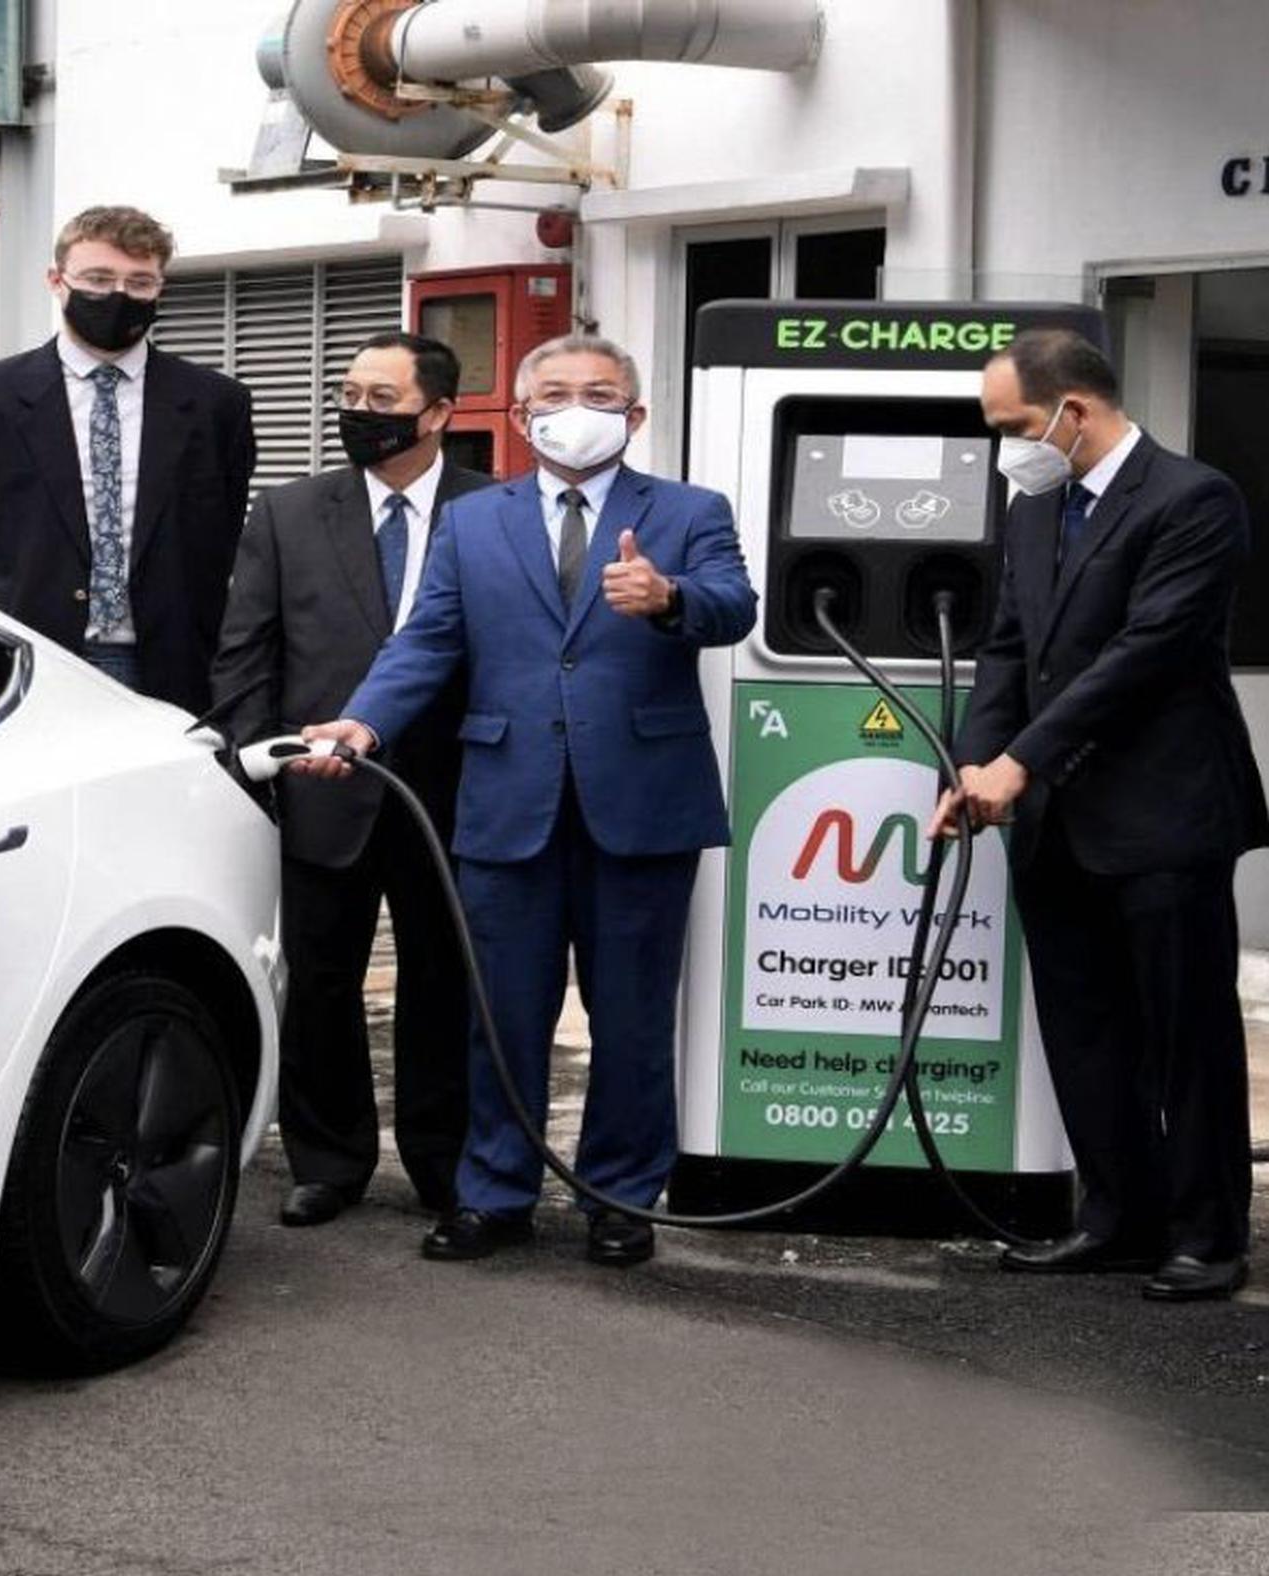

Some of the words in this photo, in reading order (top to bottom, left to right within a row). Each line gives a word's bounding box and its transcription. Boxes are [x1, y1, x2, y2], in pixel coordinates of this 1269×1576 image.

[1221, 156, 1269, 197] C
[758, 902, 890, 930] Mobility
[757, 950, 878, 981] Charger
[938, 958, 988, 982] 001
[756, 994, 785, 1008] Car
[790, 996, 828, 1010] Park
[834, 997, 854, 1011] ID:
[860, 1000, 894, 1012] MW
[899, 1002, 989, 1018] antech
[740, 1051, 806, 1070] Need
[815, 1052, 867, 1077] help
[740, 1079, 768, 1094] Call
[765, 1103, 838, 1127] 0800
